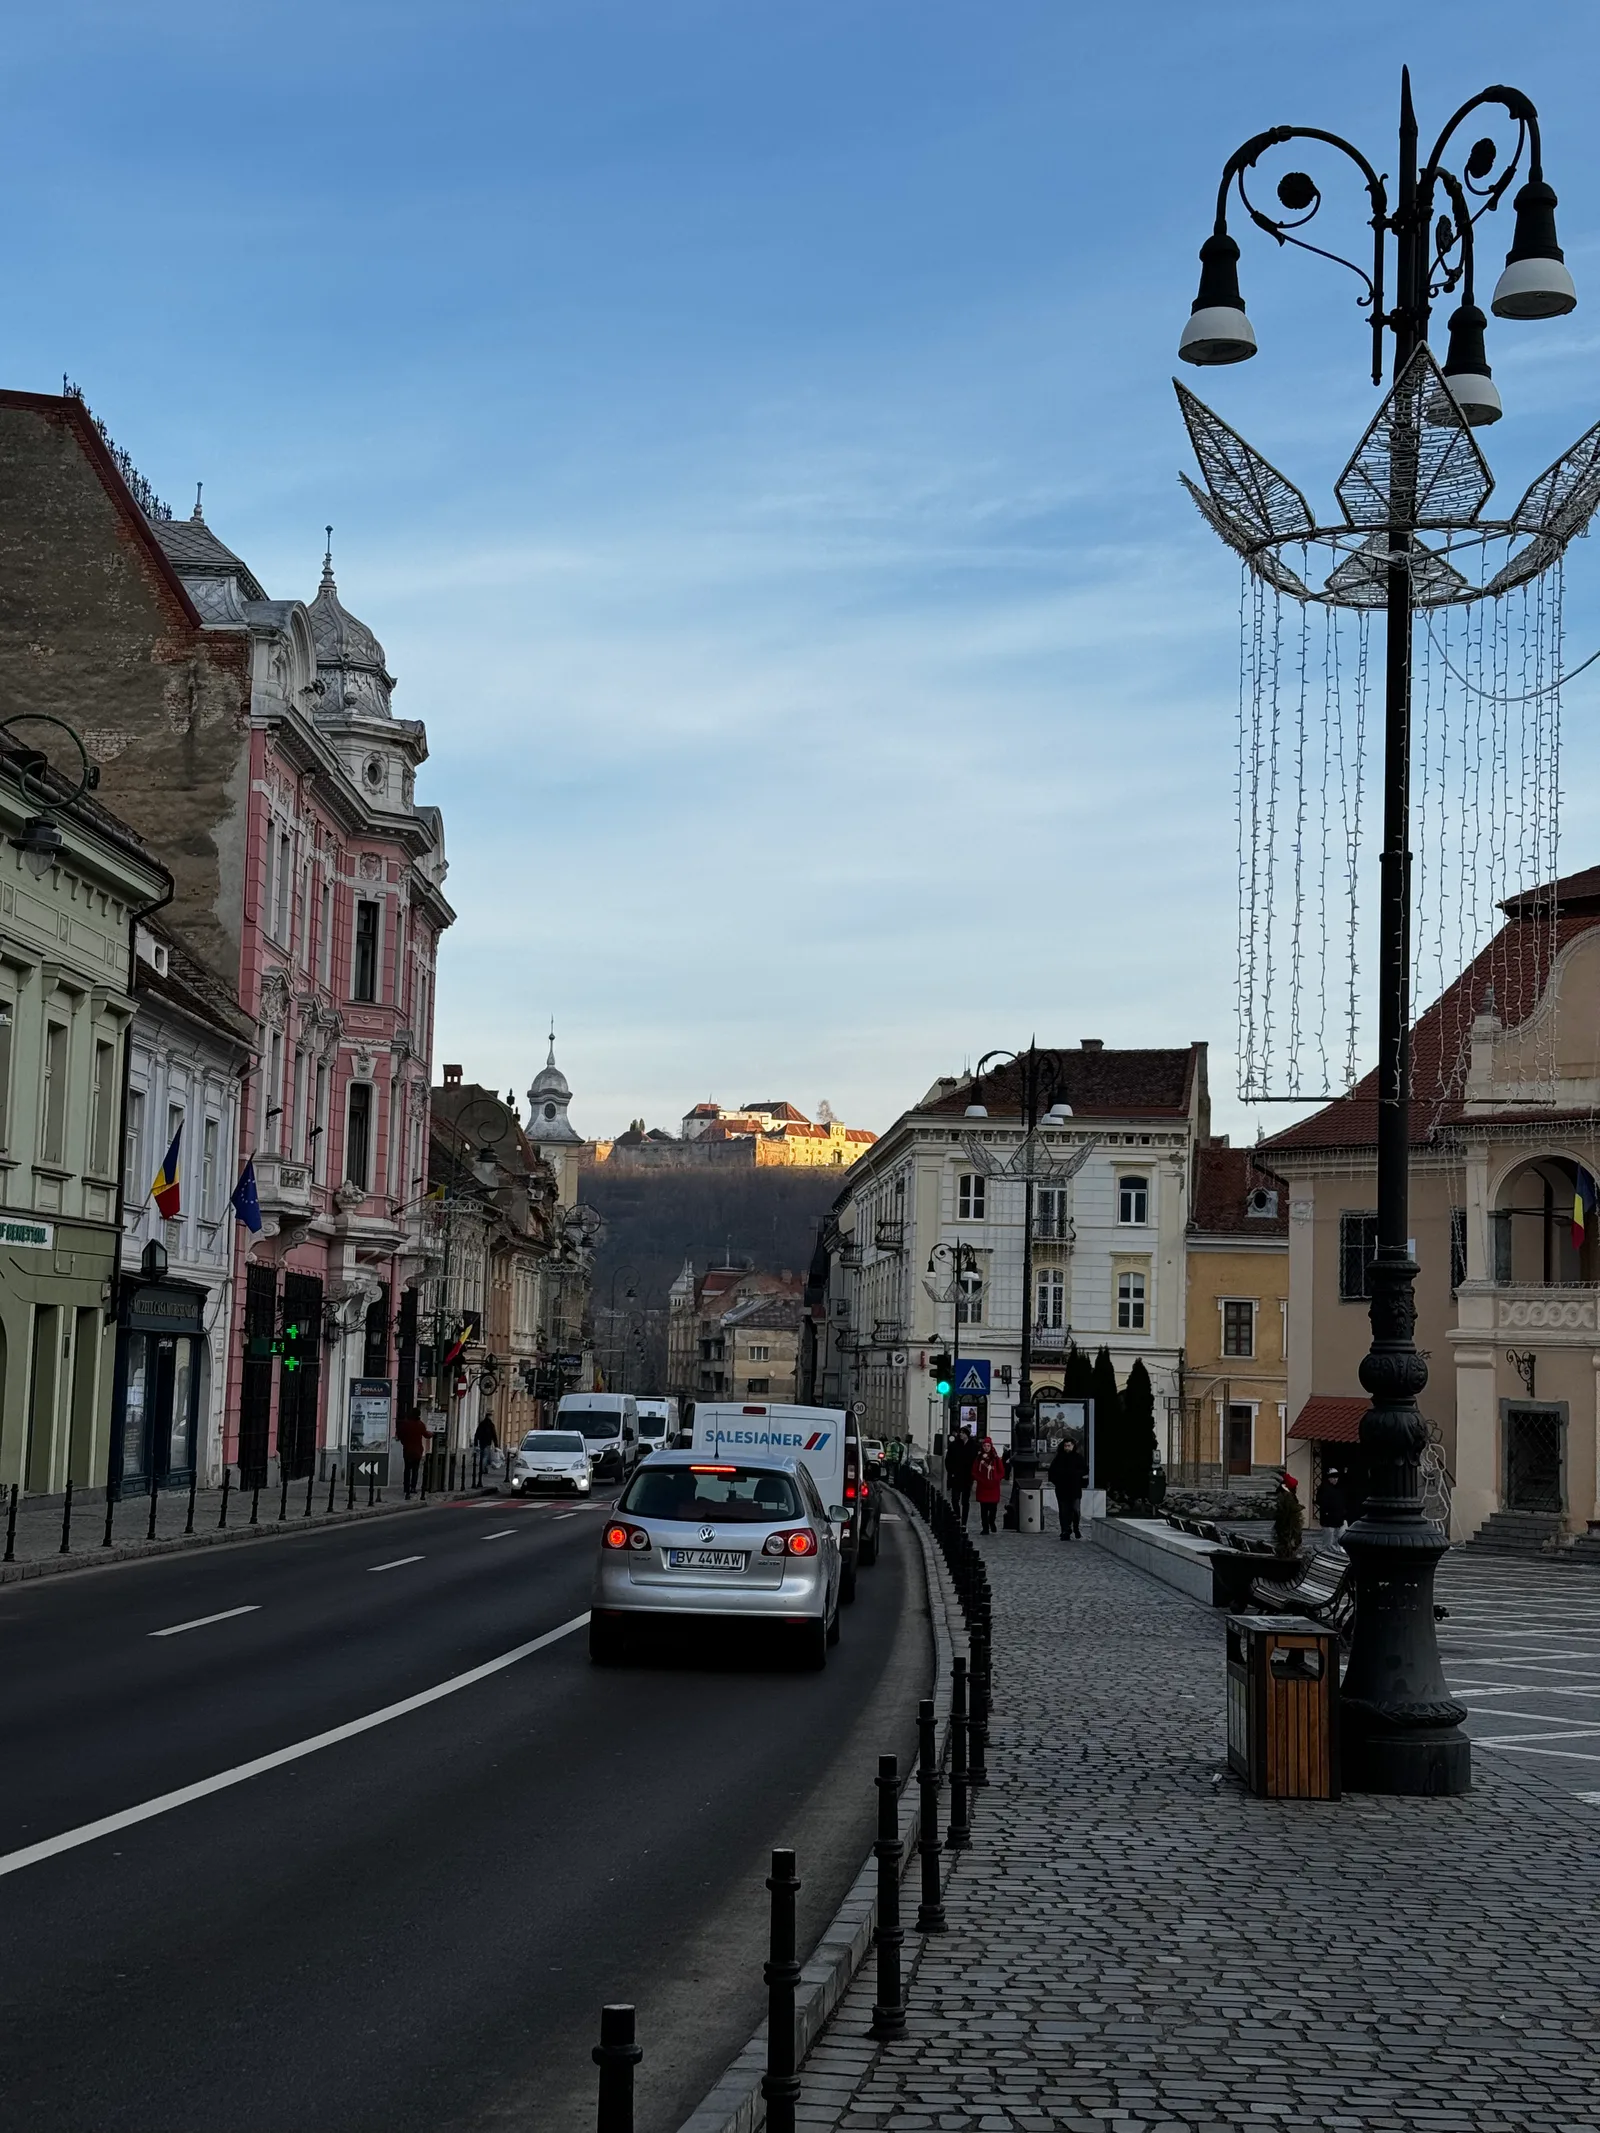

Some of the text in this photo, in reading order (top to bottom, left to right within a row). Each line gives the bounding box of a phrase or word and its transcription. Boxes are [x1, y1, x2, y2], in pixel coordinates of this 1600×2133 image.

[855, 1404, 864, 1412] 30
[705, 1430, 803, 1446] SALESIANER
[676, 1551, 694, 1563] BV
